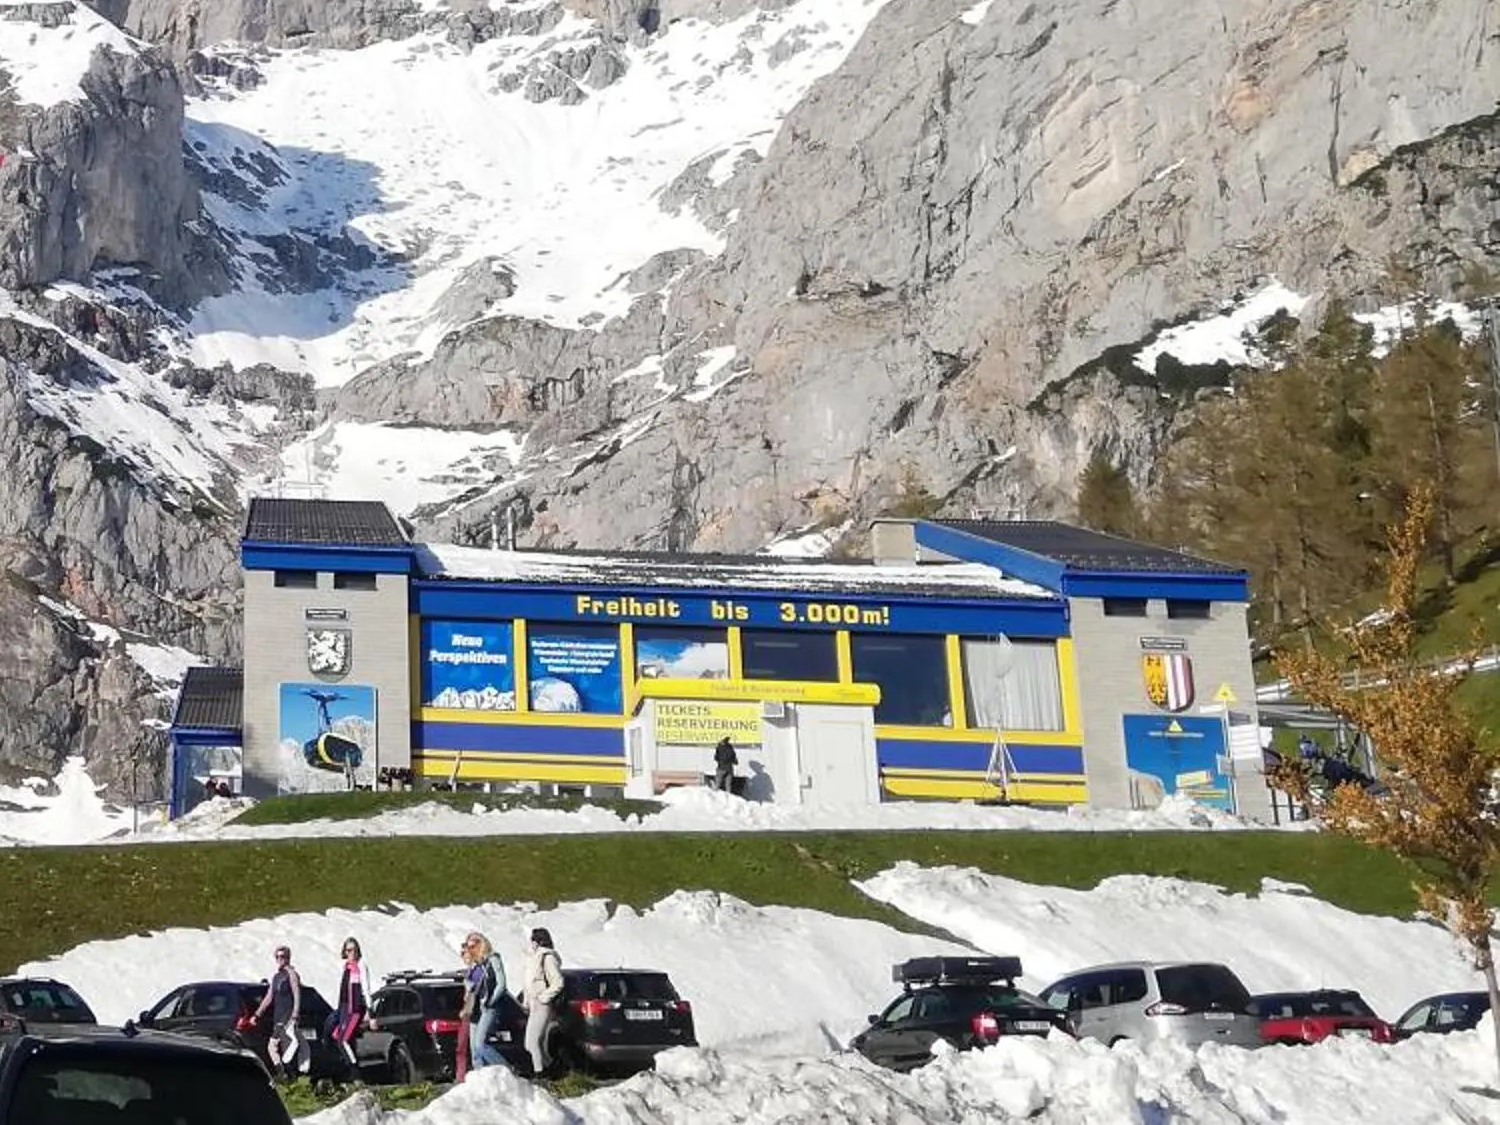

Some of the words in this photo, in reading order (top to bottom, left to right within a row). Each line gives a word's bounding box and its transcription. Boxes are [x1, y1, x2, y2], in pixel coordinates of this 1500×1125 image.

[576, 595, 681, 618] Freiheit
[711, 600, 749, 620] bis
[780, 602, 890, 625] 3.000m!
[657, 704, 712, 716] TICKETS
[657, 717, 758, 732] RESERVIERUNG
